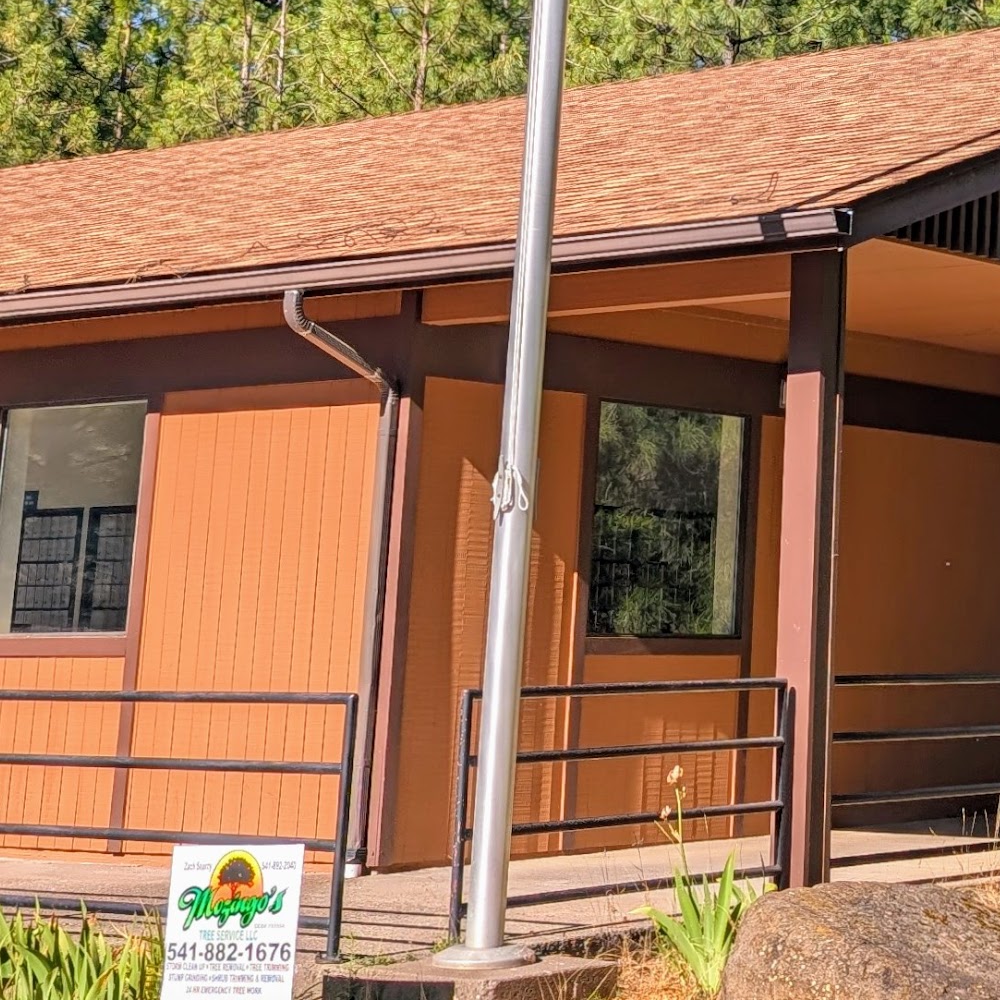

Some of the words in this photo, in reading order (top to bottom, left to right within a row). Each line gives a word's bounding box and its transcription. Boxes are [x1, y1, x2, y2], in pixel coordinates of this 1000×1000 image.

[178, 885, 289, 931] Mozingo's
[199, 930, 216, 941] TREE
[216, 930, 244, 941] SERVICE
[246, 930, 258, 941] LLC
[167, 942, 291, 962] 541-882-1676
[209, 963, 221, 971] TREE
